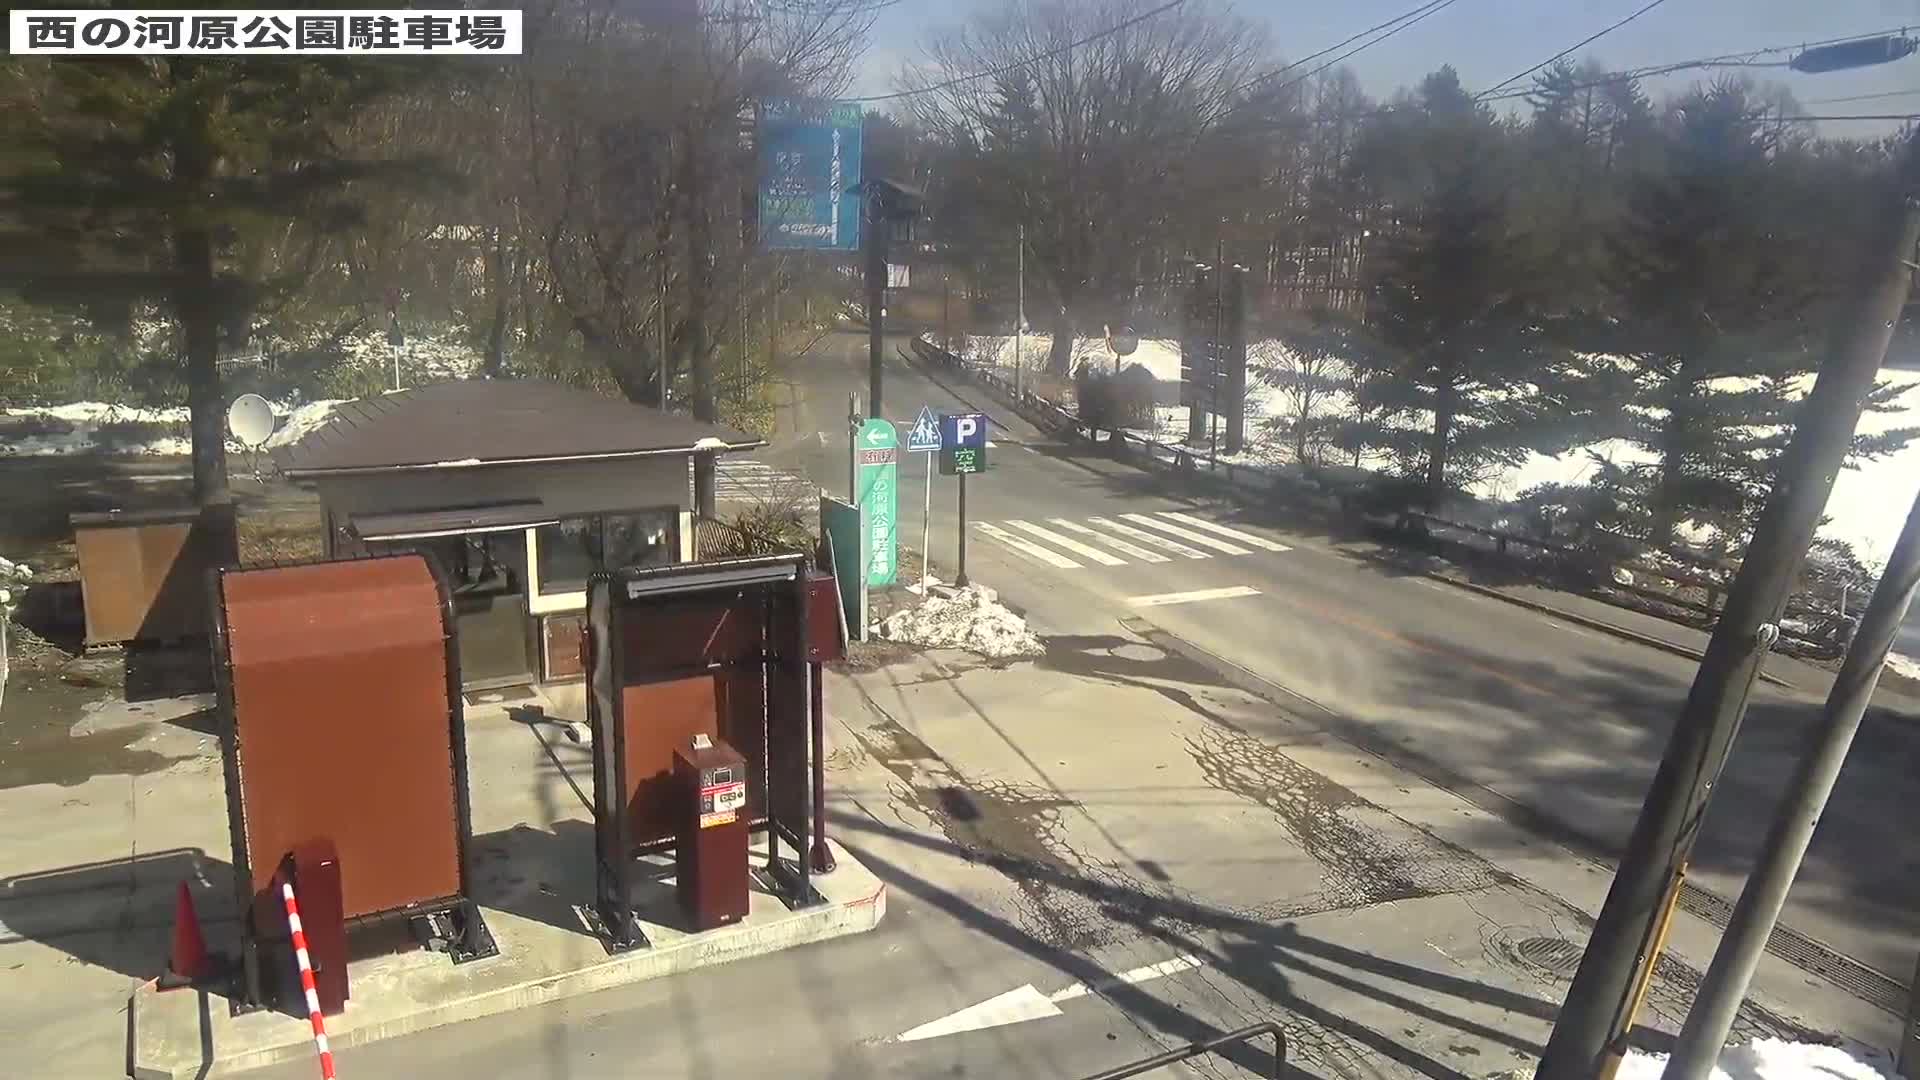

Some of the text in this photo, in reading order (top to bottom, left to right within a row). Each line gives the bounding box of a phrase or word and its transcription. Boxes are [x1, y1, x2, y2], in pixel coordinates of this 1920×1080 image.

[957, 418, 977, 444] P
[871, 471, 889, 576] の河原公園駐車場
